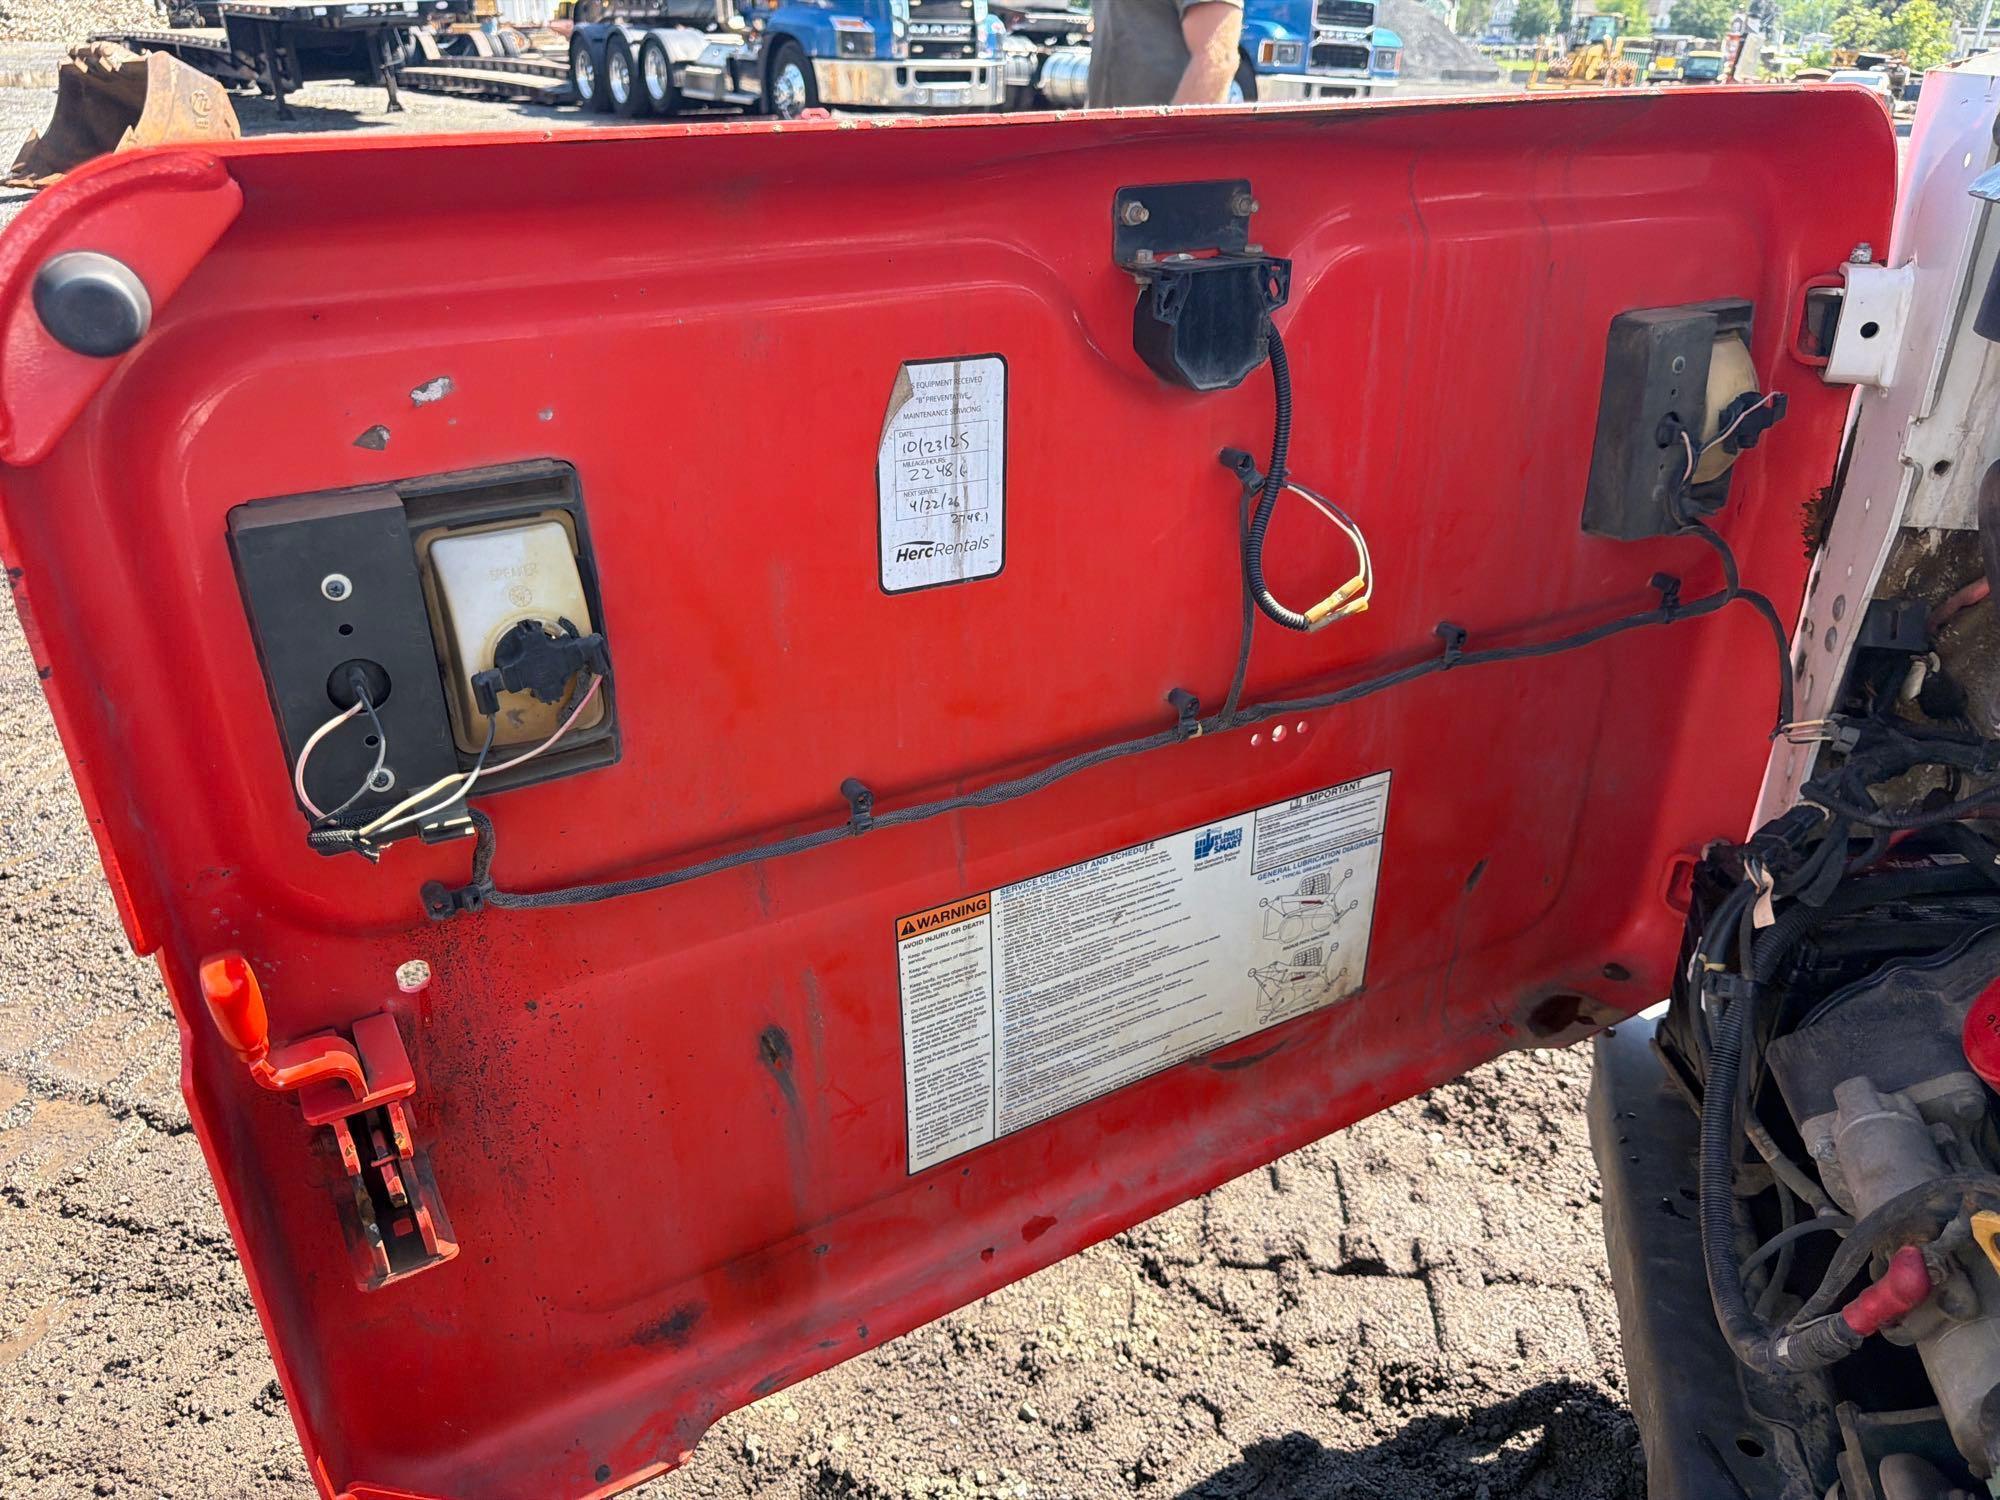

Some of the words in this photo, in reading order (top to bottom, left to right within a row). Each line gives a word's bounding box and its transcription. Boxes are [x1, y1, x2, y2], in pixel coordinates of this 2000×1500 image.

[916, 379, 952, 390] EQUIPMENT
[954, 375, 983, 385] RECEIVED
[926, 392, 969, 403] PREVENTATIVE
[903, 410, 949, 420] MAINTENANCE
[950, 405, 981, 416] SERVICING
[903, 490, 917, 498] NEXT
[918, 488, 939, 497] SERVICE
[1306, 780, 1362, 804] IMPORTANT
[1213, 838, 1242, 854] SMART
[999, 877, 1037, 895] SERVICE
[1040, 862, 1087, 883] CHECKLIST
[1090, 856, 1108, 867] AND
[1110, 842, 1155, 861] SCHEDULE
[1257, 864, 1291, 881] GENERAL
[1292, 847, 1340, 870] LUBRICATION
[1342, 836, 1378, 854] DIAGRAMS
[917, 899, 986, 928] WARNING
[903, 938, 923, 949] AVOID
[925, 930, 949, 942] INJURY
[951, 926, 960, 934] OR
[962, 919, 984, 931] DEATH
